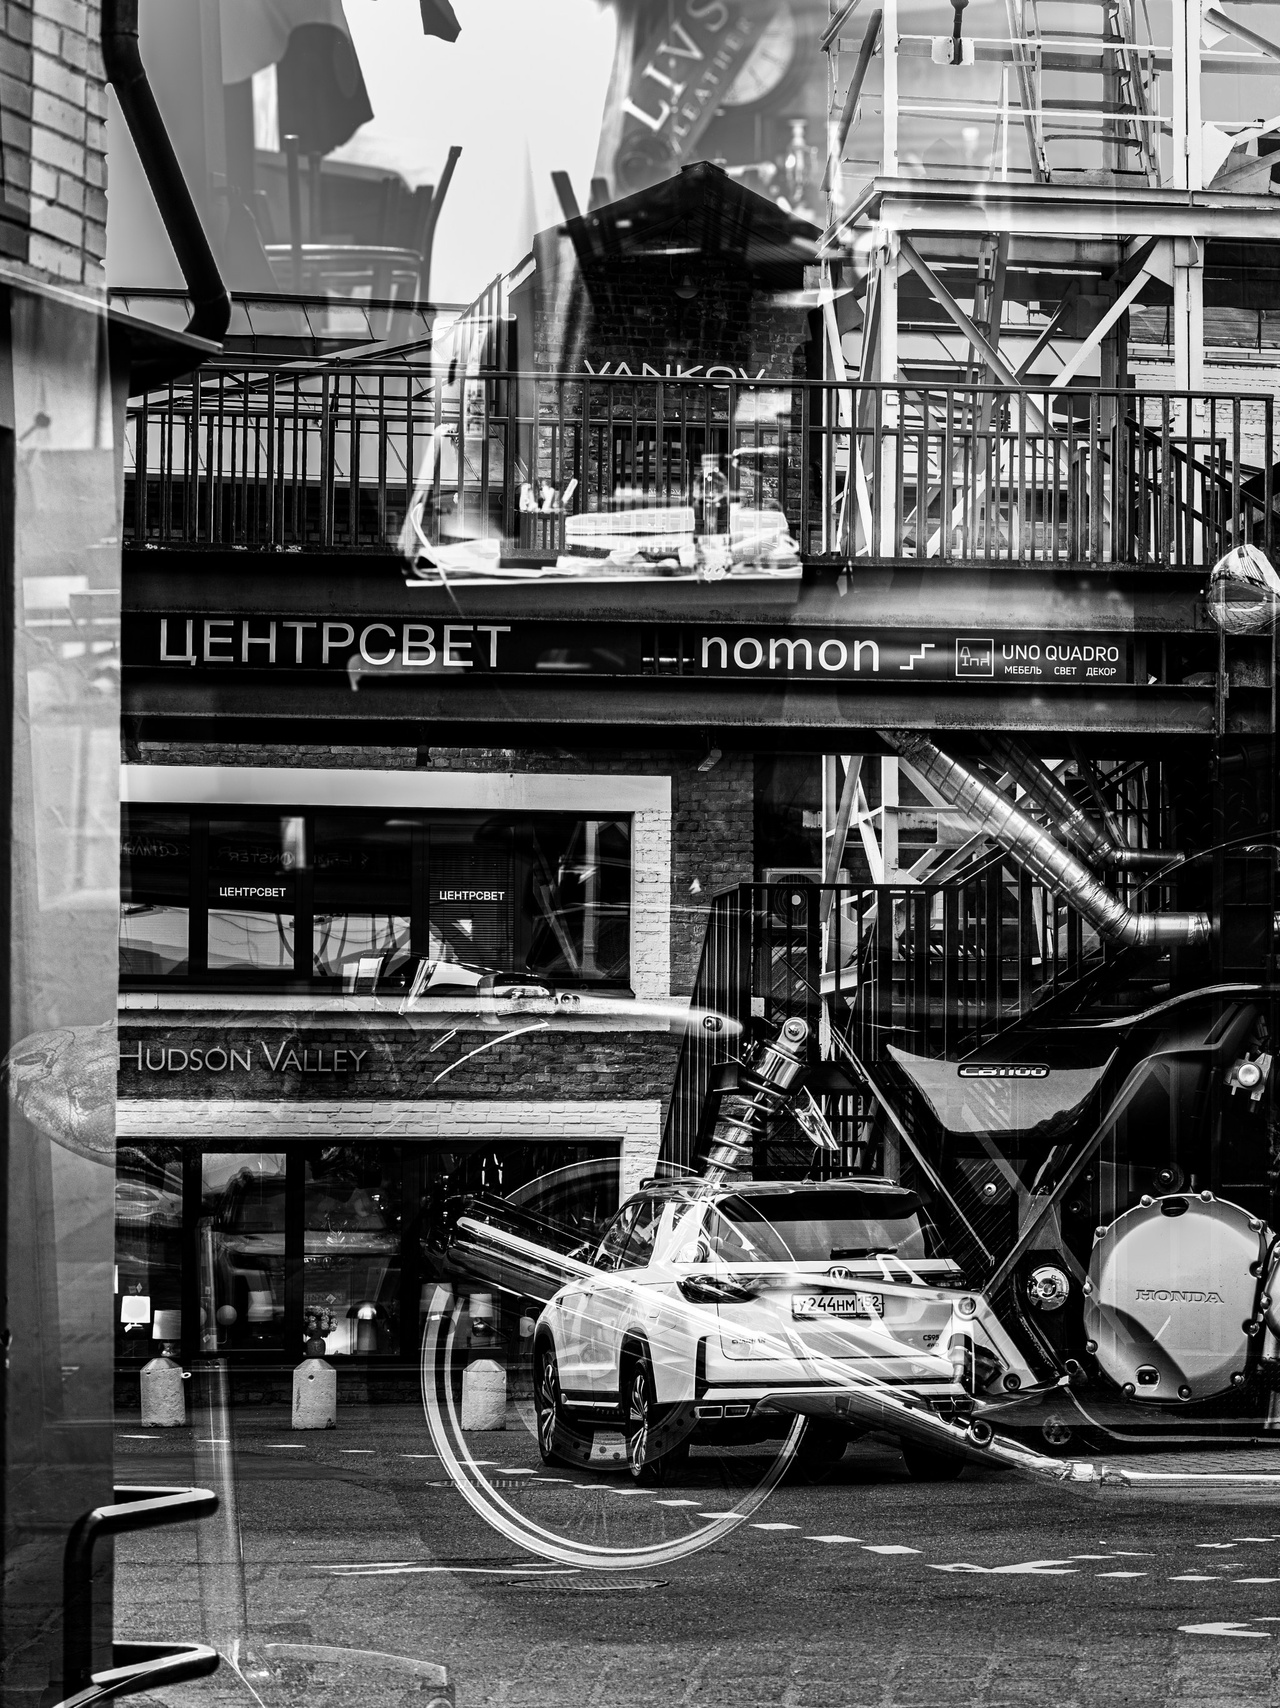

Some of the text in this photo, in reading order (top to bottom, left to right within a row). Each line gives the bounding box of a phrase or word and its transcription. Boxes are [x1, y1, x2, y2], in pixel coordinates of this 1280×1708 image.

[160, 618, 511, 667] ЦЕНТРСВЕТ
[701, 636, 880, 672] nomon
[1002, 644, 1119, 662] UNO QUADRO
[1004, 665, 1117, 677] МЕБЕЛЬ СВЕТ ДЕКОР
[219, 887, 286, 897] ЦЕНТРСВЕТ
[439, 890, 505, 901] ЦЕНТРСВЕТ
[261, 1041, 368, 1071] VALLEY
[960, 1067, 1047, 1076] CB1100
[1136, 1289, 1225, 1304] HONDA
